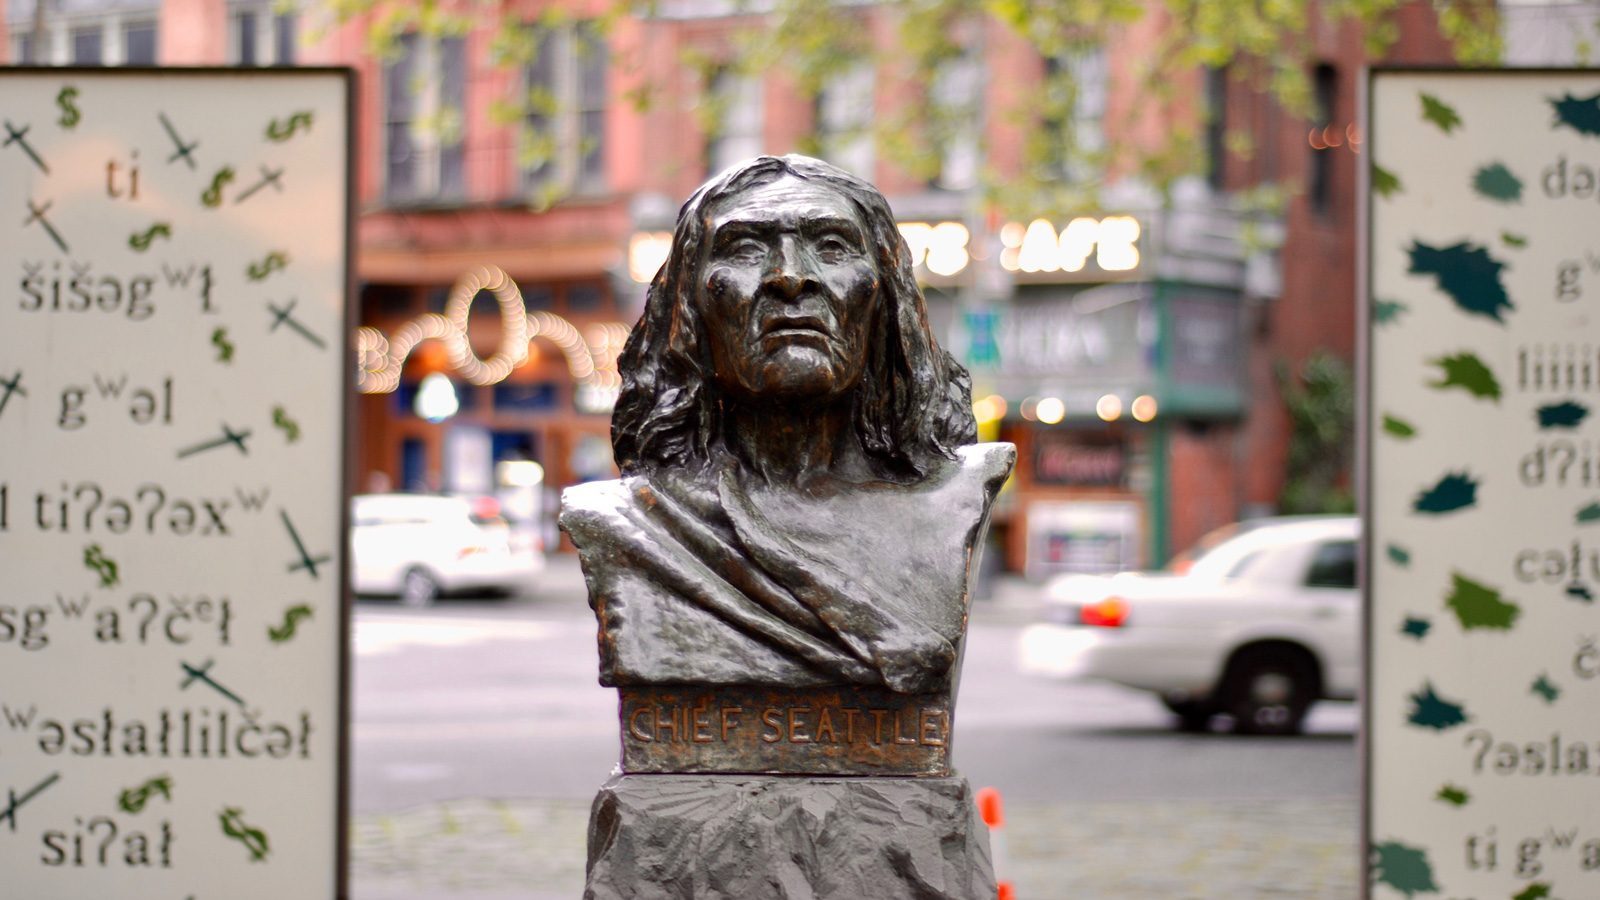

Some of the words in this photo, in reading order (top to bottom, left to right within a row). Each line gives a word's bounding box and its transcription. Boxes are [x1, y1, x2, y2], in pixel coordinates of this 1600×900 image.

[106, 149, 140, 200] ti
[1541, 154, 1600, 200] də
[629, 707, 742, 744] CHIEF
[762, 707, 945, 747] SEATTLE
[1465, 824, 1499, 871] ti
